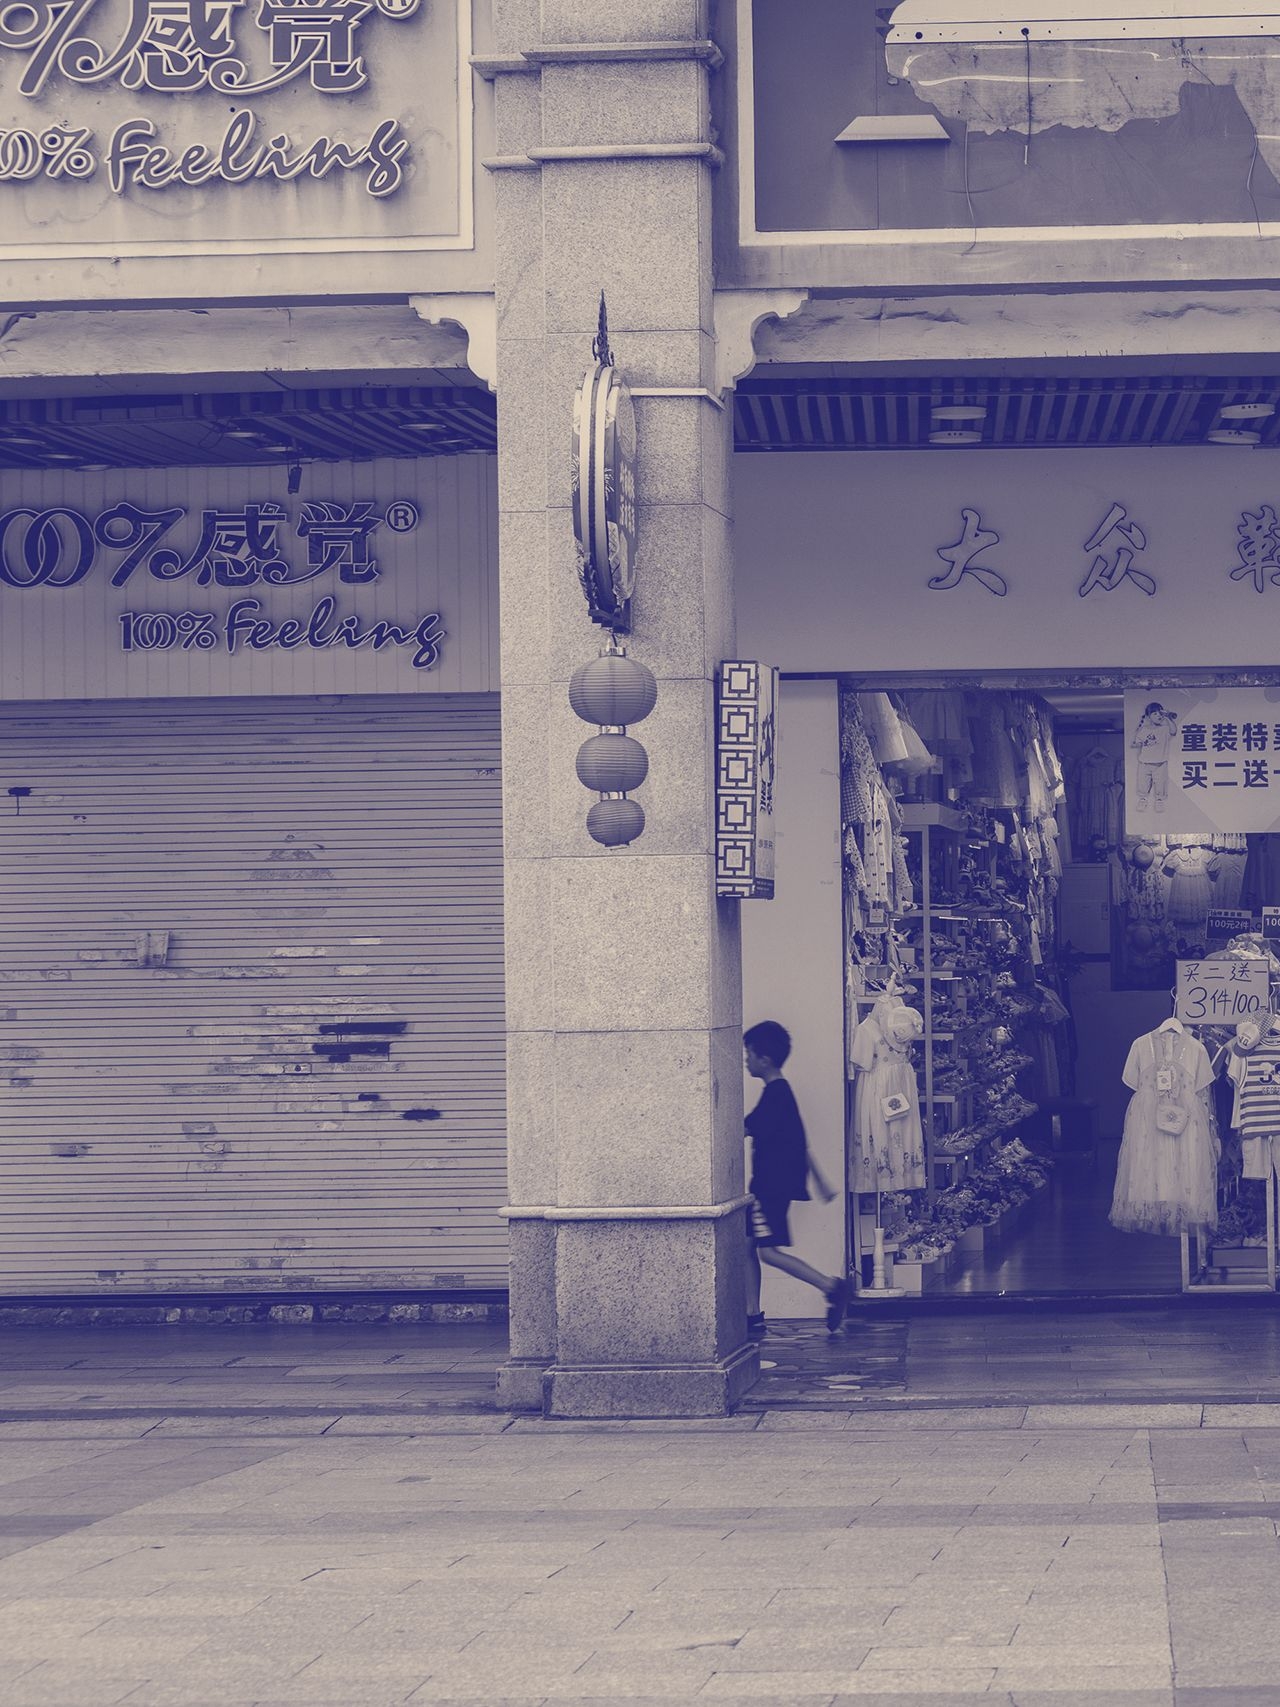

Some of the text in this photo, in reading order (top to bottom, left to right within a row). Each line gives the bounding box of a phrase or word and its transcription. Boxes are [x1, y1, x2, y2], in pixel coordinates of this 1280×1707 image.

[118, 611, 217, 652] 100%
[1209, 919, 1249, 930] 100元2件
[1183, 962, 1267, 983] 买二送一
